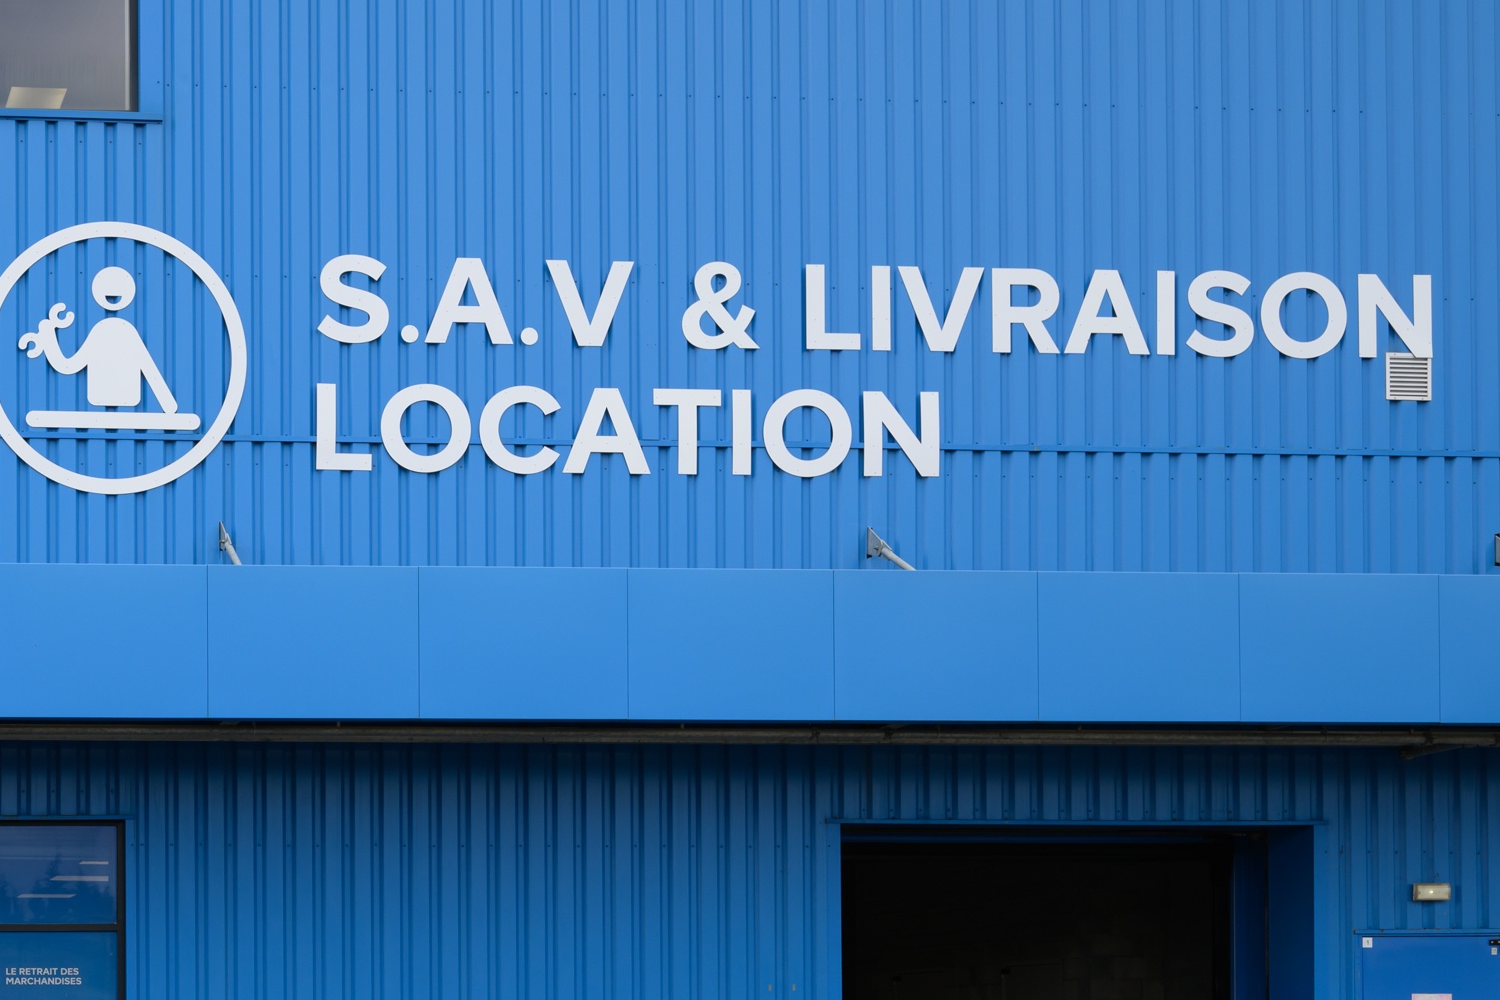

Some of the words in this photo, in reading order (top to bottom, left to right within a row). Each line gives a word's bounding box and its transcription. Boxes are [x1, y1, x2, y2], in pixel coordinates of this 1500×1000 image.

[317, 254, 635, 347] S.A.V
[682, 262, 760, 350] &
[806, 264, 1433, 359] LIVRAISON
[315, 383, 941, 478] LOCATION
[5, 967, 17, 976] LE
[19, 967, 58, 976] RETRAIT
[60, 967, 80, 976] DES
[5, 977, 82, 985] MARCHANDISES
